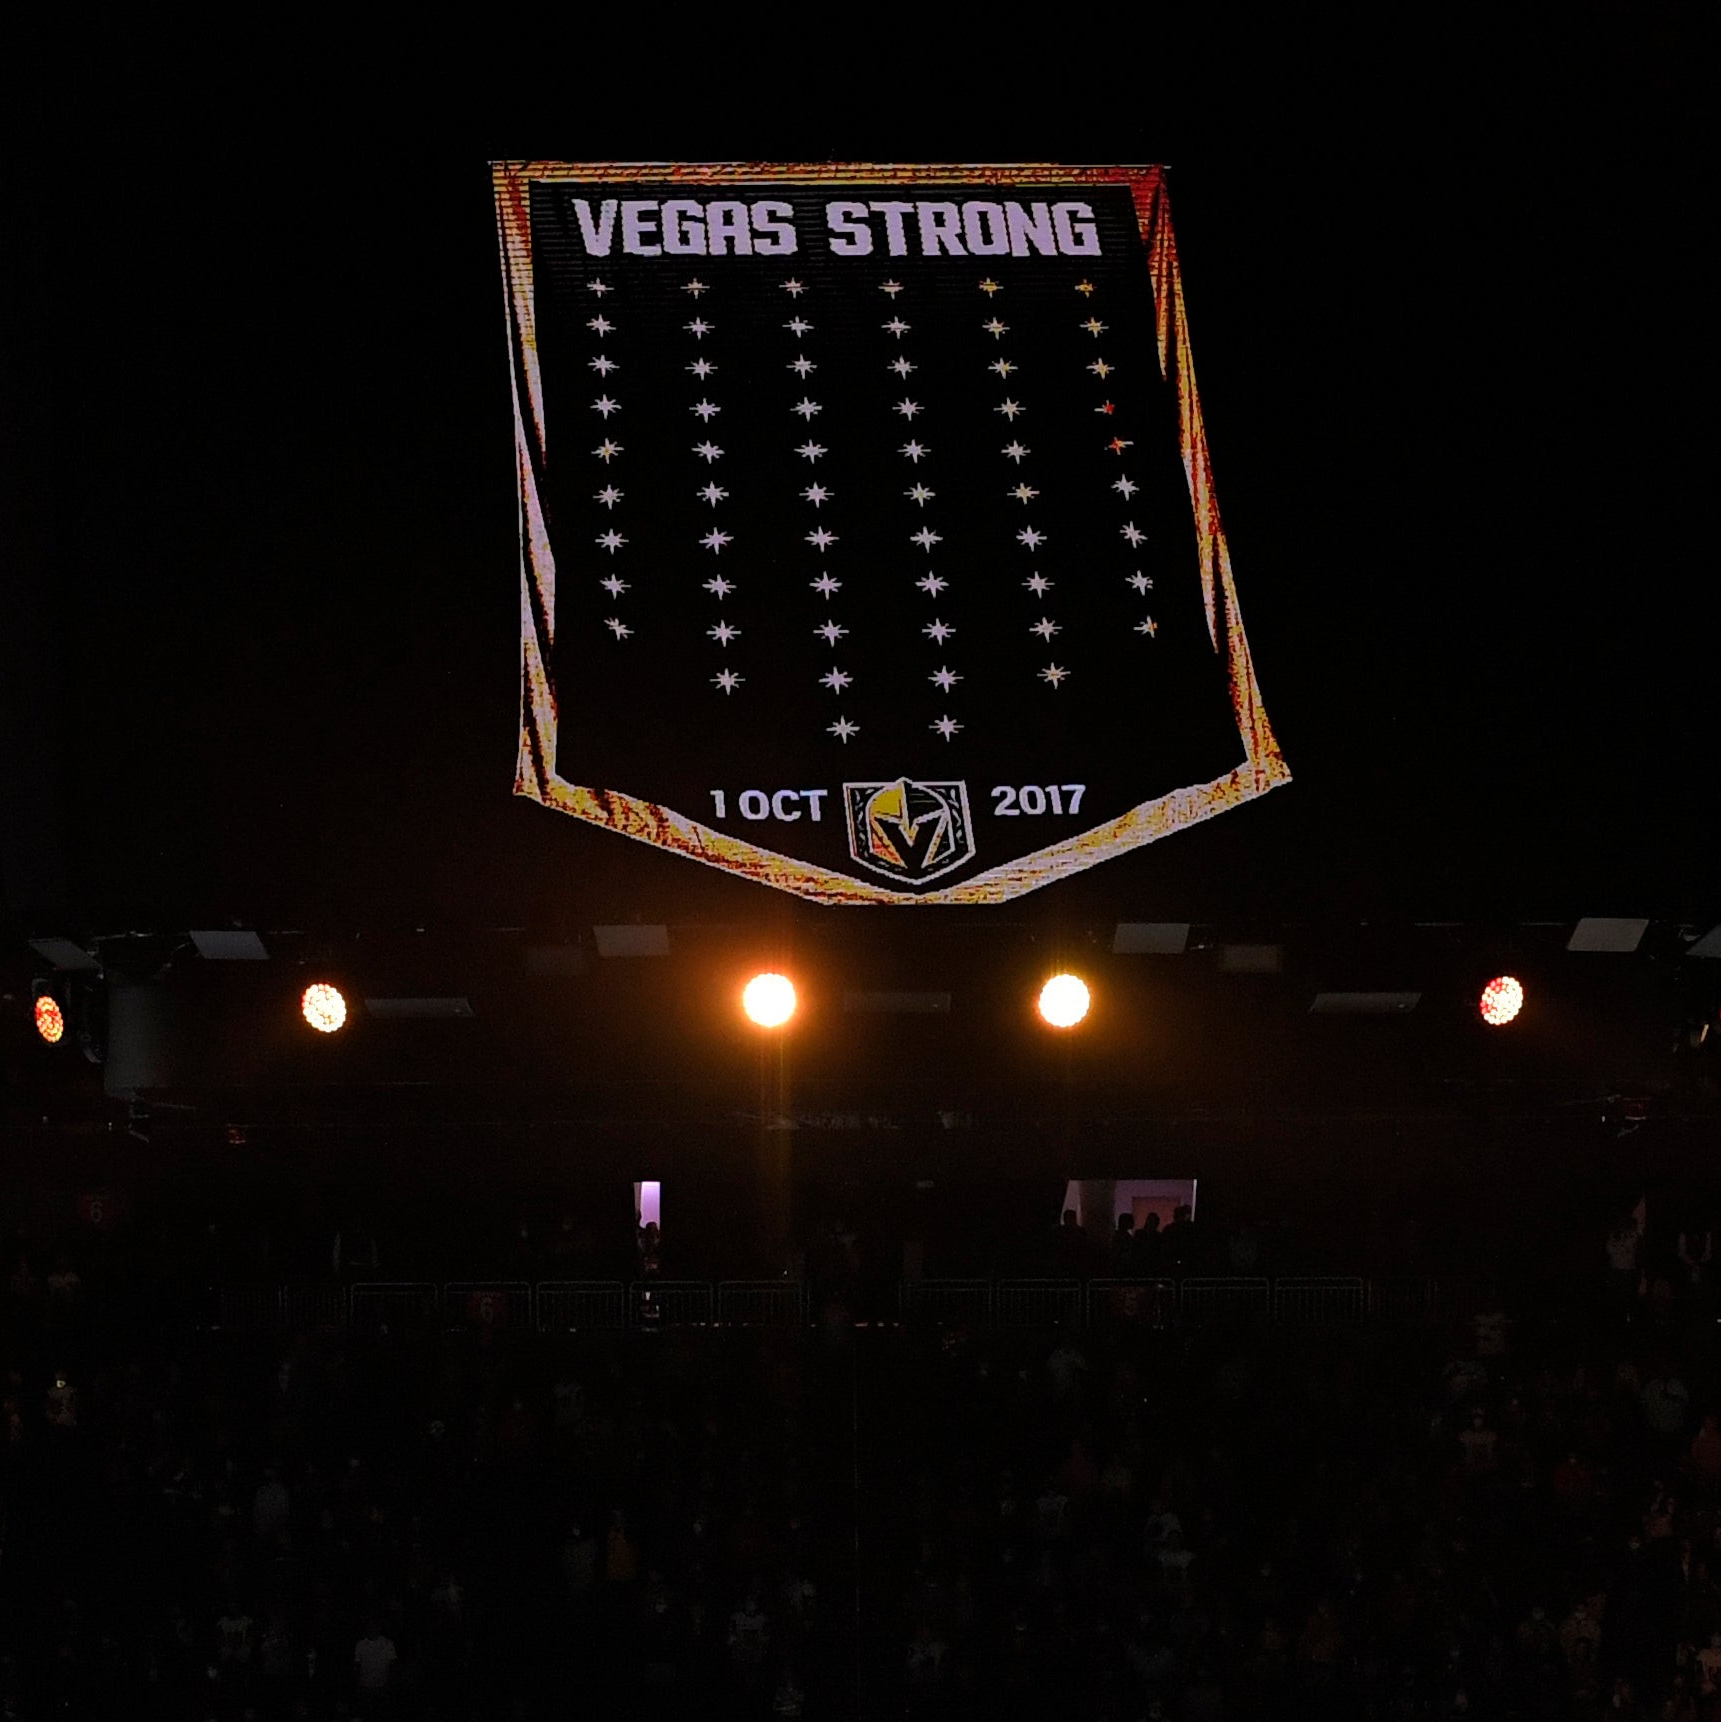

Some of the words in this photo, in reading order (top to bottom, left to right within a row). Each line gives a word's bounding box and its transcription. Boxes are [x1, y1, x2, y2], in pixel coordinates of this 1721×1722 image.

[572, 199, 797, 257] VEGAS
[825, 201, 1102, 258] STRONG
[710, 790, 726, 819] 1
[739, 790, 828, 821] OCT
[991, 784, 1086, 816] 2017
